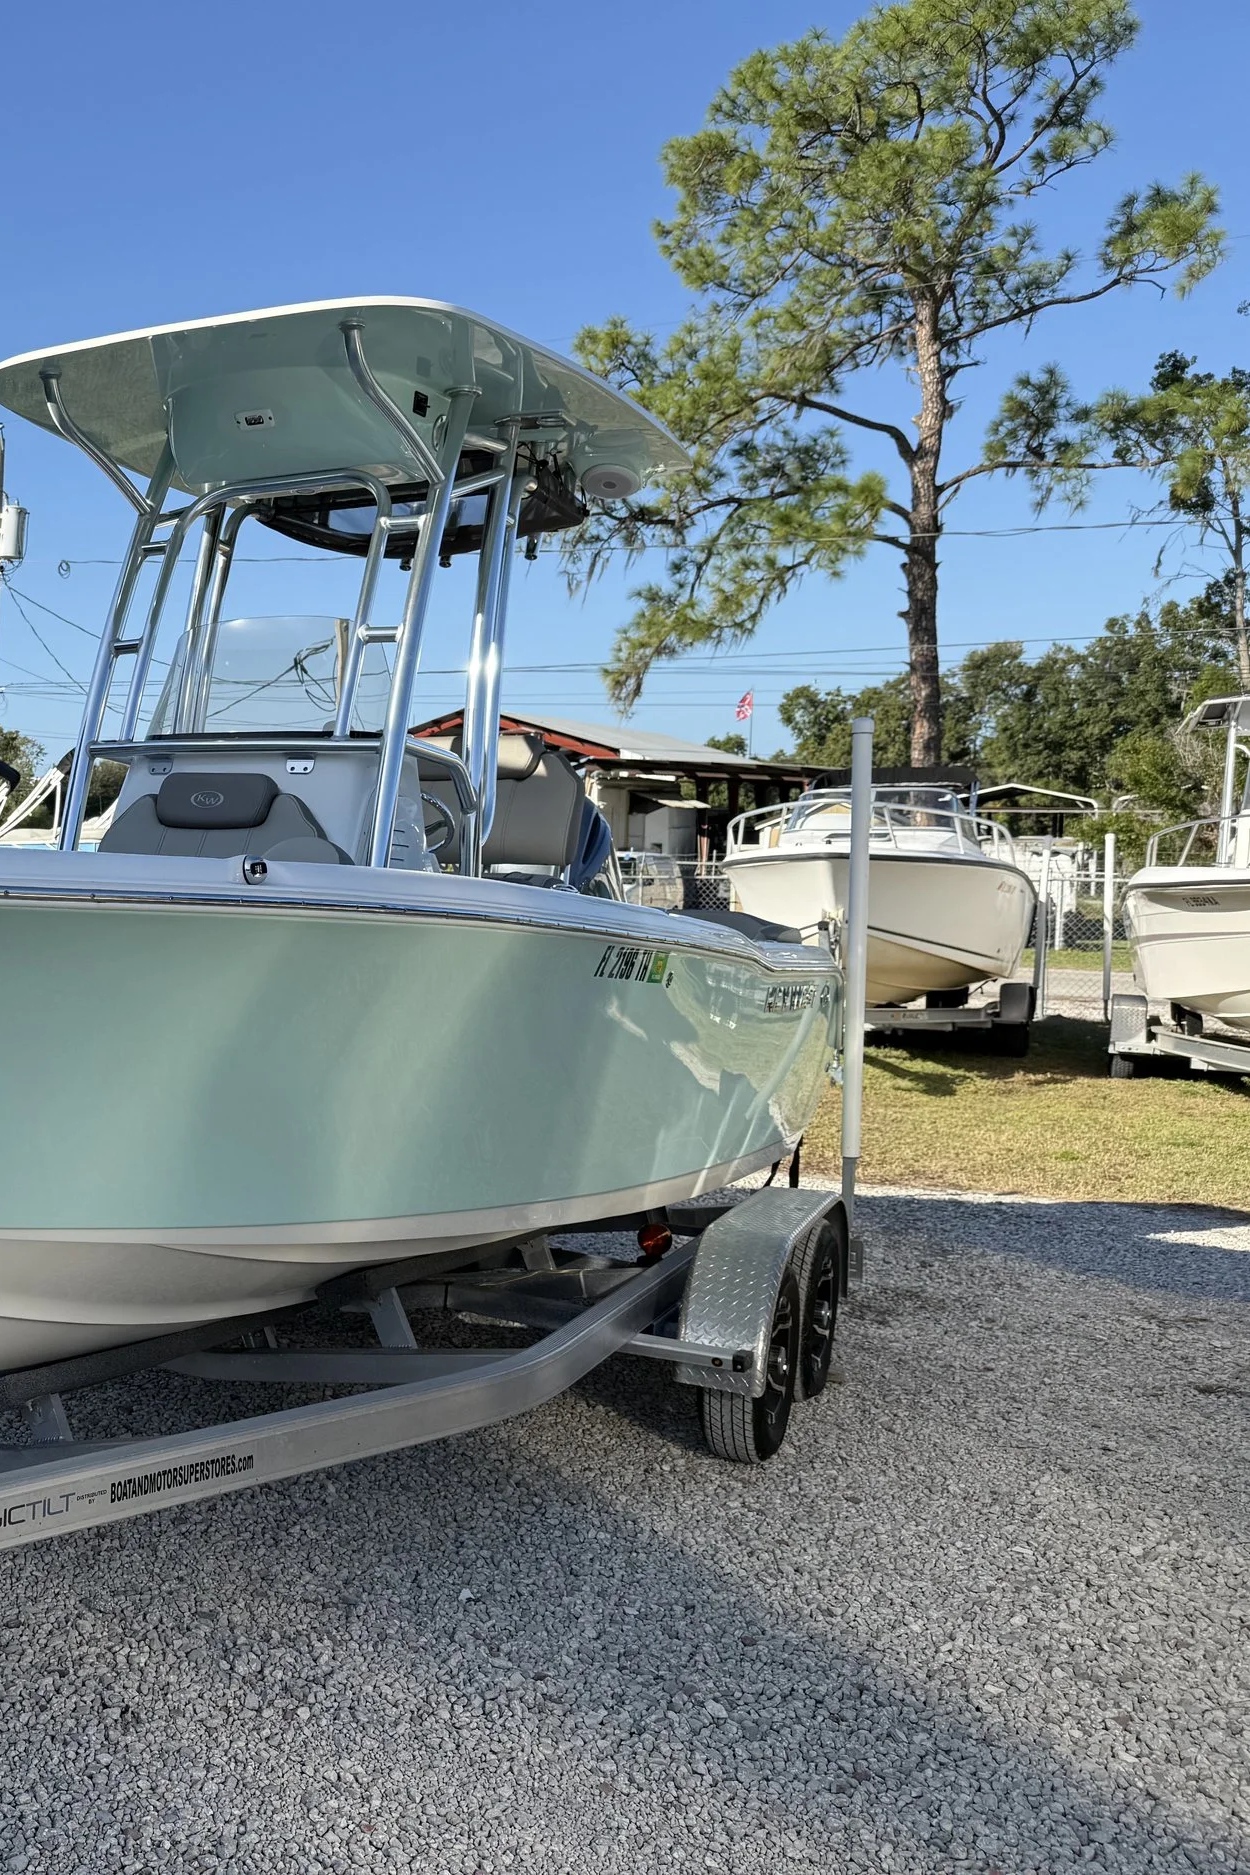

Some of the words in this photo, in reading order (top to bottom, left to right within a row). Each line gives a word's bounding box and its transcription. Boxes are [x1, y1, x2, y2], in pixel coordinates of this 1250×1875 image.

[197, 794, 219, 804] KW
[594, 945, 615, 977] FL
[110, 1454, 254, 1504] BOATANDMOTORSUPERSTORES.com
[76, 1489, 108, 1501] DISTRIBUTED
